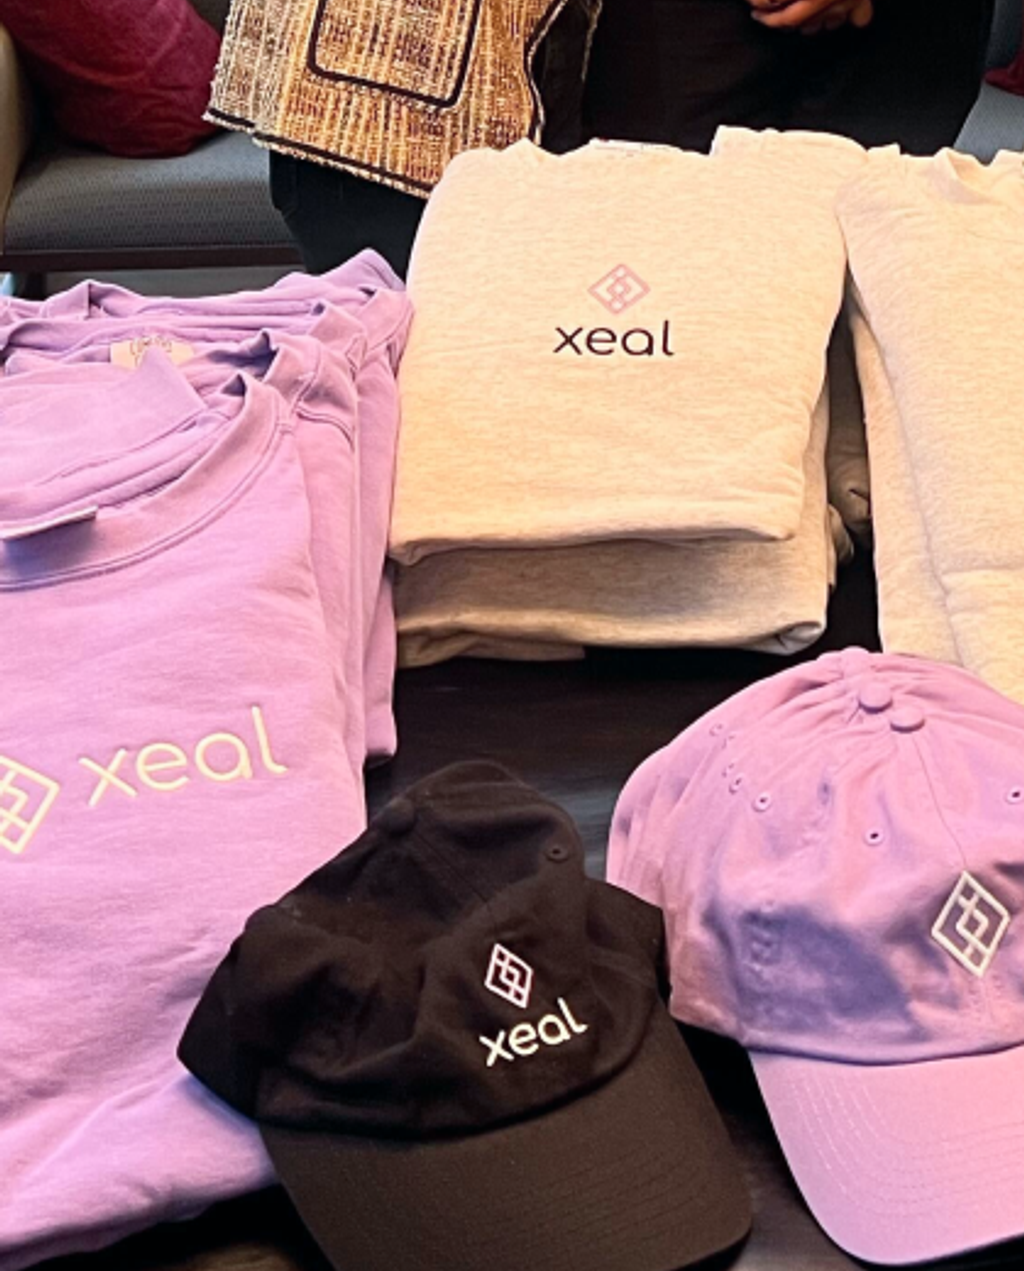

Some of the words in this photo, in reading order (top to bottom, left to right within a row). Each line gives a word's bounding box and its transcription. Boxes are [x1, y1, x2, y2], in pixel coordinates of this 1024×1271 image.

[553, 319, 675, 356] xeal
[78, 705, 288, 807] xeal
[479, 997, 588, 1067] xeal
